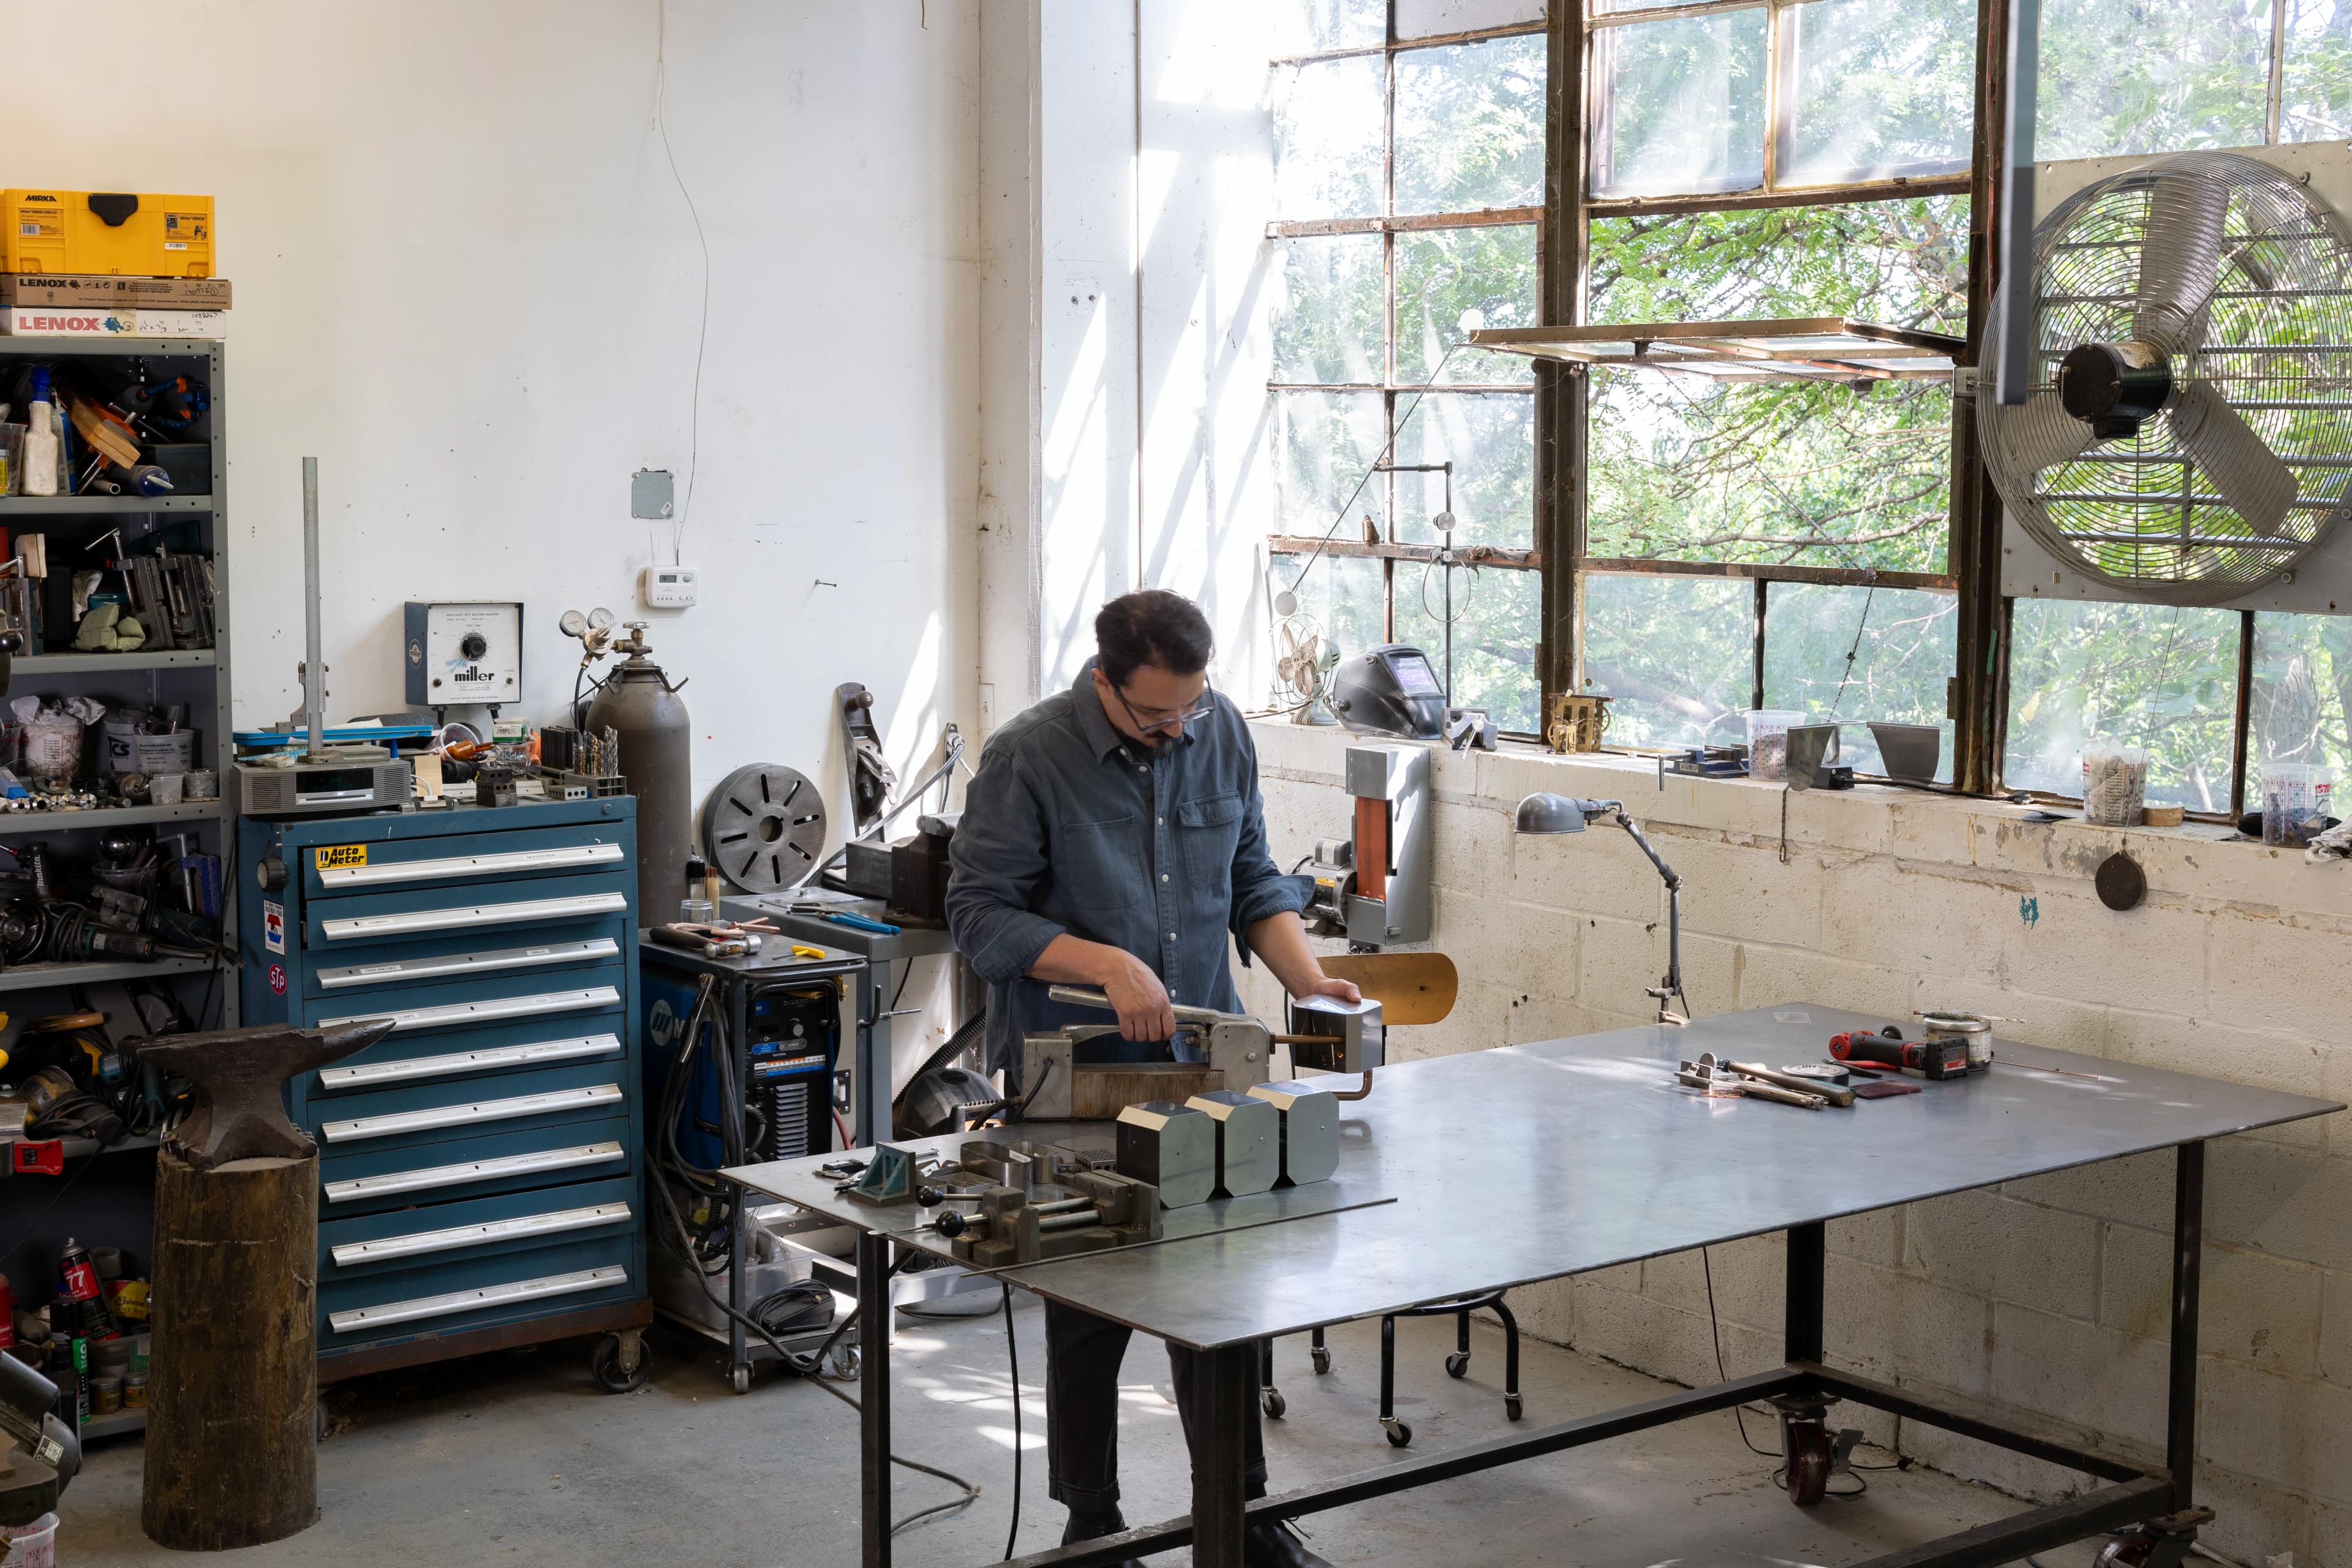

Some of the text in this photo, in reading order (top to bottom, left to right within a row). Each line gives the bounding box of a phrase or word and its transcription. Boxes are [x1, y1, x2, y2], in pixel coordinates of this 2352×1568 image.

[19, 278, 67, 288] LENOX
[19, 316, 100, 331] LENOX
[410, 646, 421, 657] miller
[454, 666, 494, 682] miller
[331, 847, 359, 857] Auto
[329, 856, 364, 865] Meter
[34, 854, 44, 889] makita
[271, 967, 285, 989] STP
[65, 1270, 85, 1291] 77
